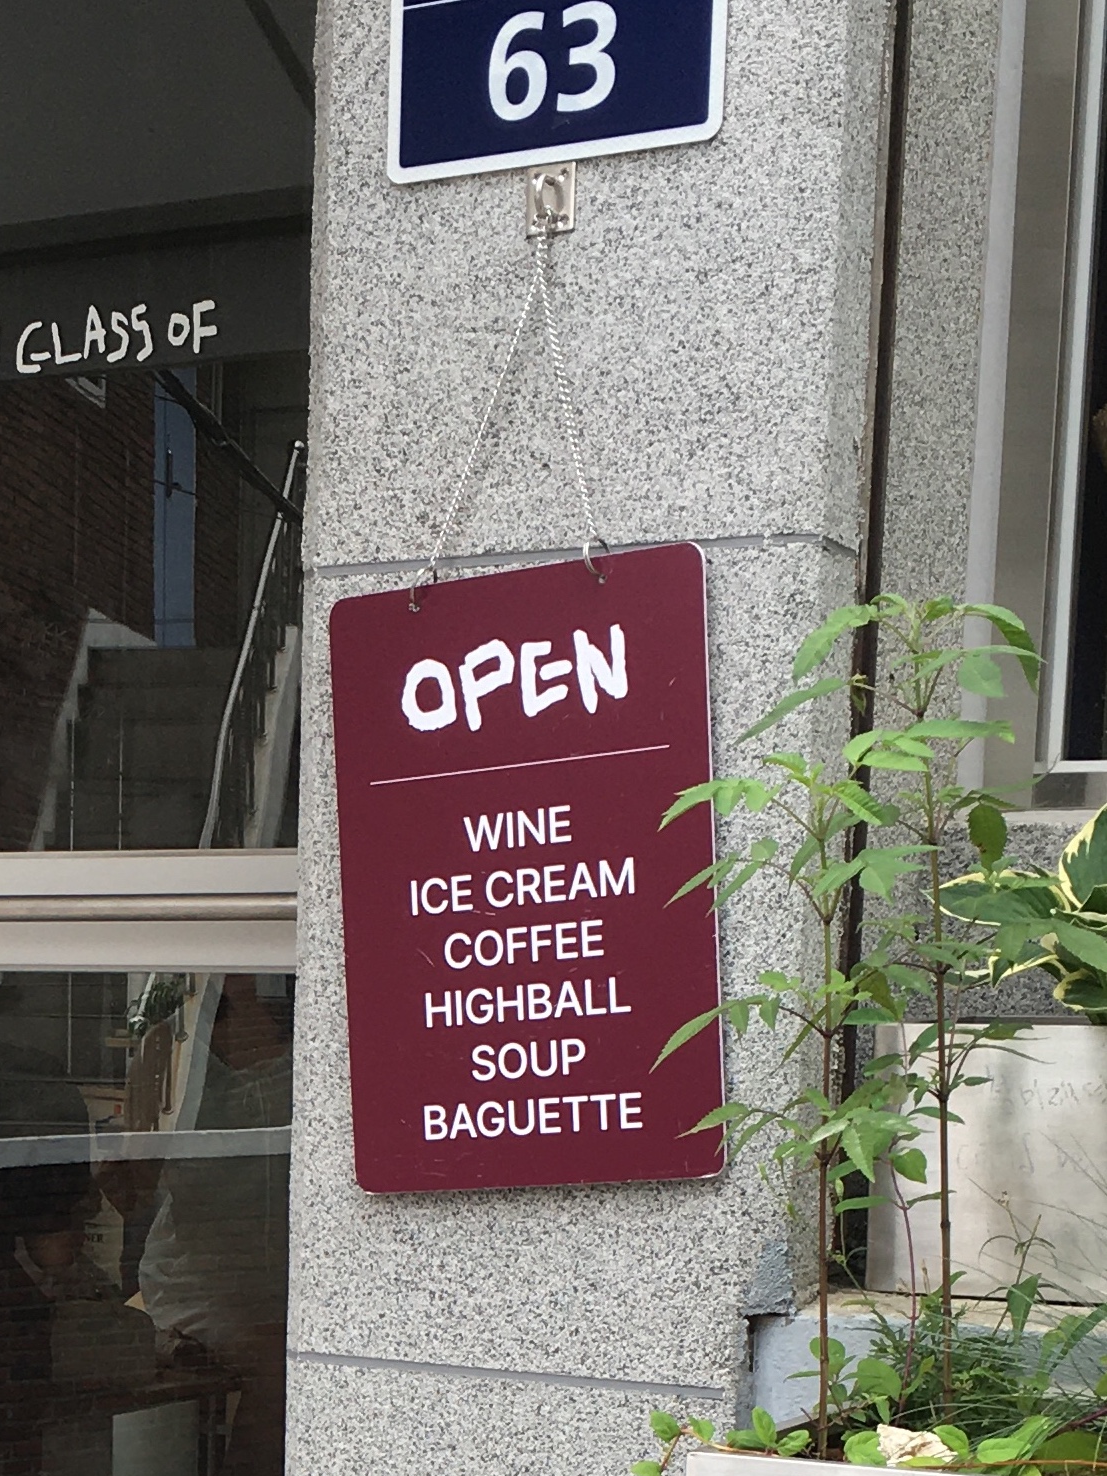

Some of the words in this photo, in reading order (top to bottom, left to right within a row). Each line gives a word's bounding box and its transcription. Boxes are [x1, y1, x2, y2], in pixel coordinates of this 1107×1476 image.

[489, 1, 616, 120] 63
[16, 304, 153, 373] GLASS
[168, 300, 217, 353] OF
[402, 624, 628, 731] OPEN
[464, 805, 571, 851] WINE
[411, 875, 473, 915] ICE
[486, 857, 634, 907] CREAM
[445, 920, 604, 968] COFFEE
[426, 977, 631, 1027] HIGHBALL
[472, 1039, 585, 1080] SOUP
[424, 1092, 642, 1140] BAGUETTE
